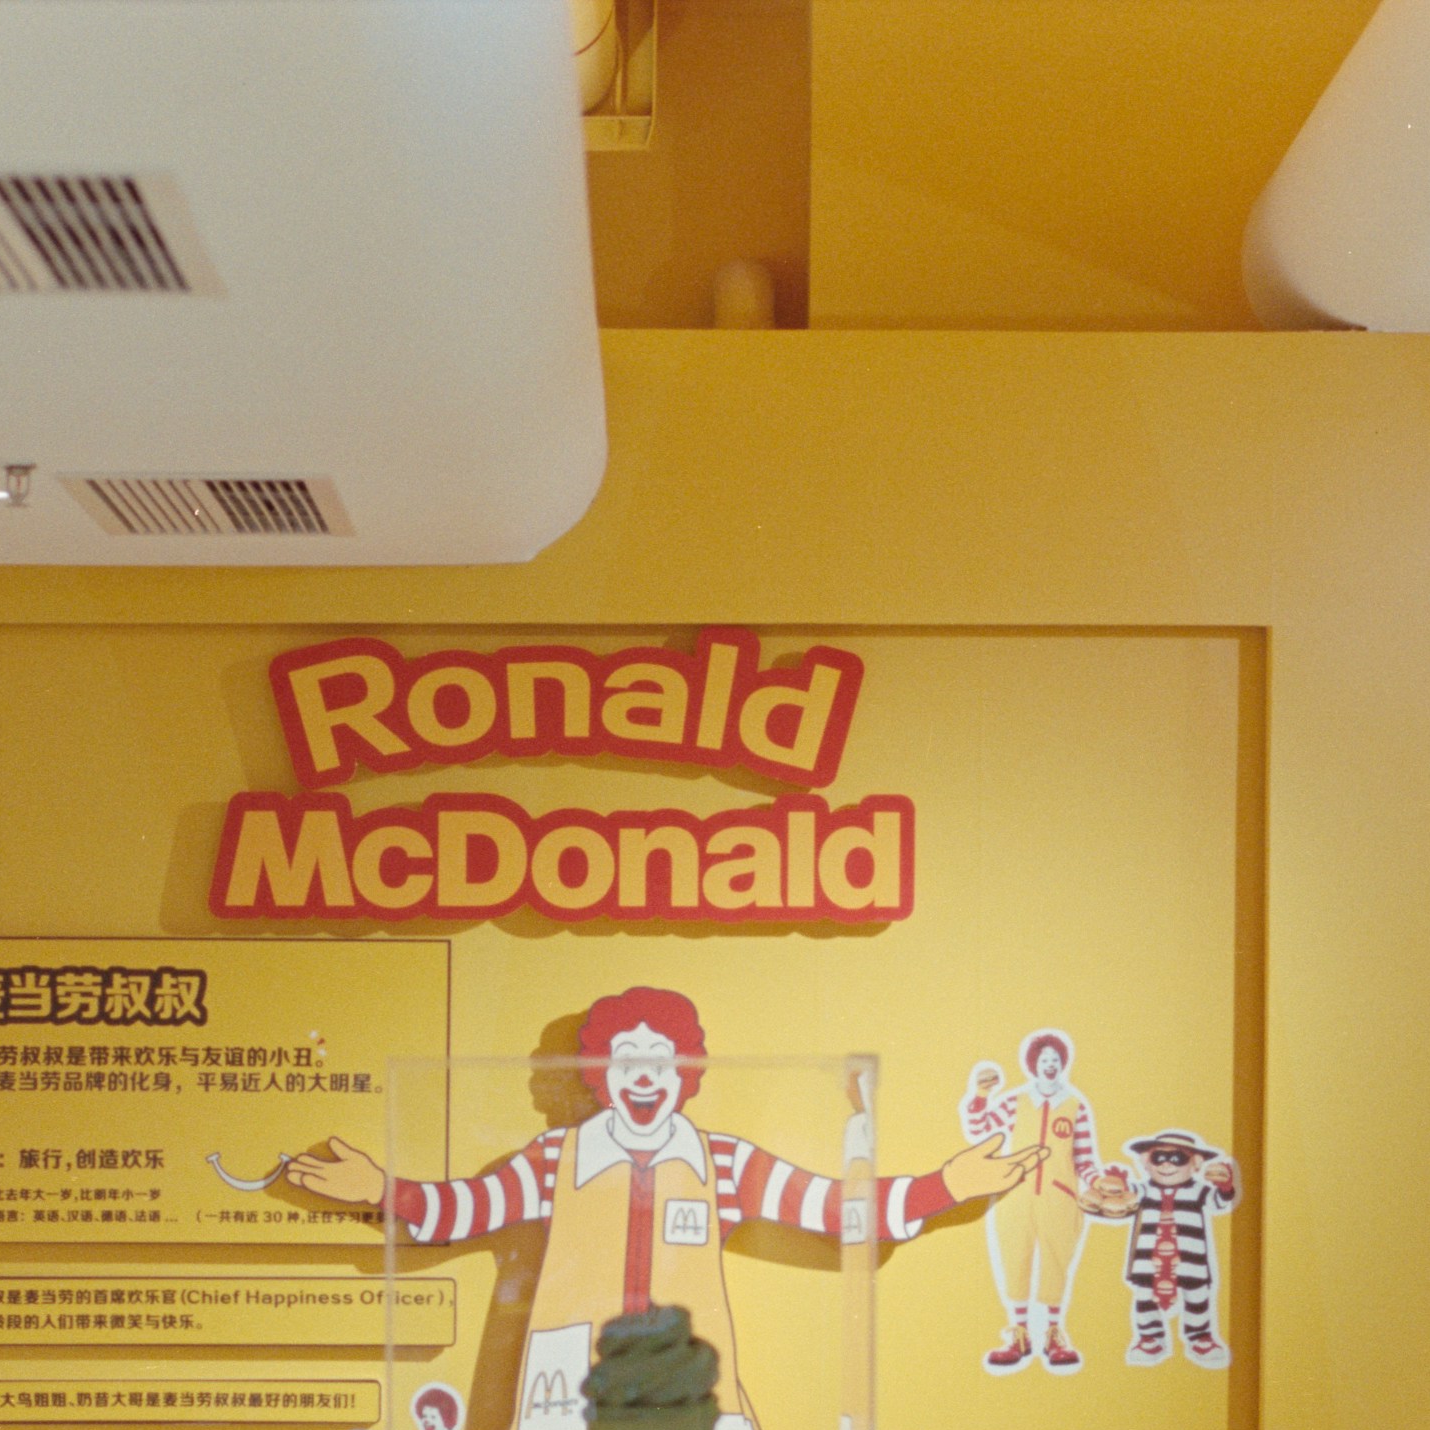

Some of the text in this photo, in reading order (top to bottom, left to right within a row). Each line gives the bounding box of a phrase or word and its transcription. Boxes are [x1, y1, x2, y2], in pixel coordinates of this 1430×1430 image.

[288, 642, 842, 772] Ronald
[224, 811, 901, 910] McDonald
[263, 1211, 283, 1224] 30
[246, 1288, 354, 1308] Happiness
